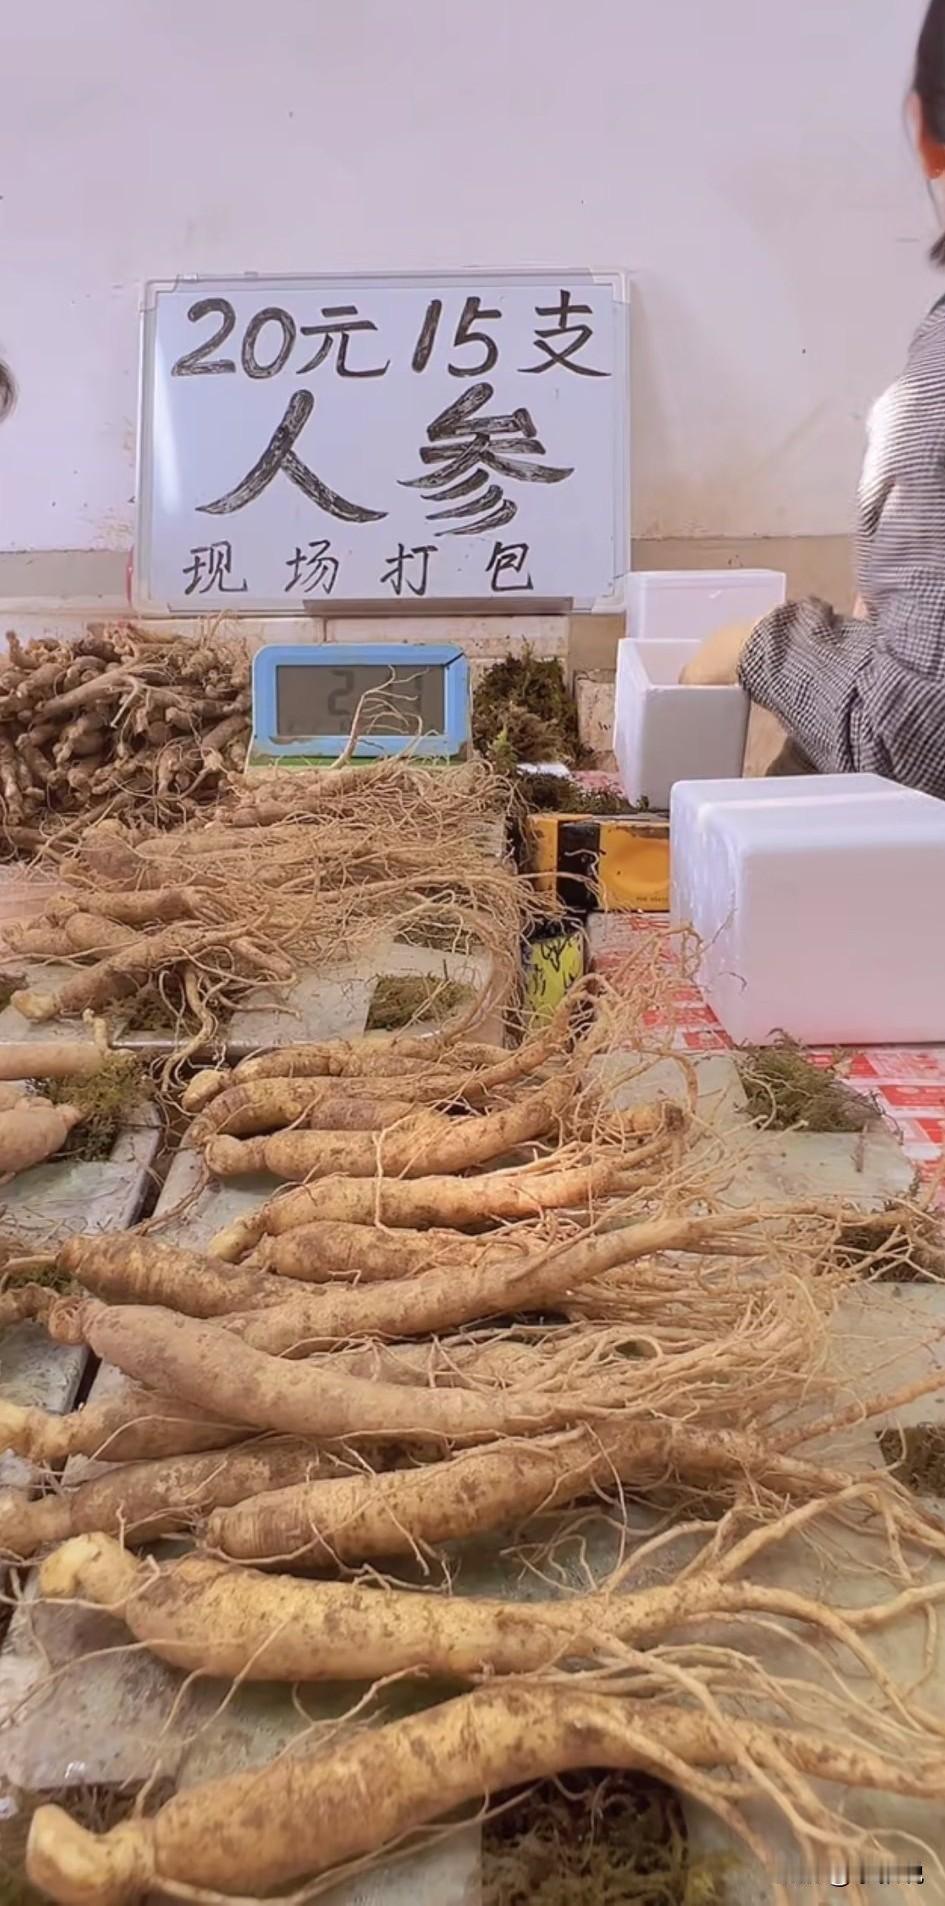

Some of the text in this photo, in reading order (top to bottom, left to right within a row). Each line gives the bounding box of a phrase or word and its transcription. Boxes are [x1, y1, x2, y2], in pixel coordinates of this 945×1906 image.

[195, 382, 575, 537] 人参
[182, 540, 534, 596] 现场打包
